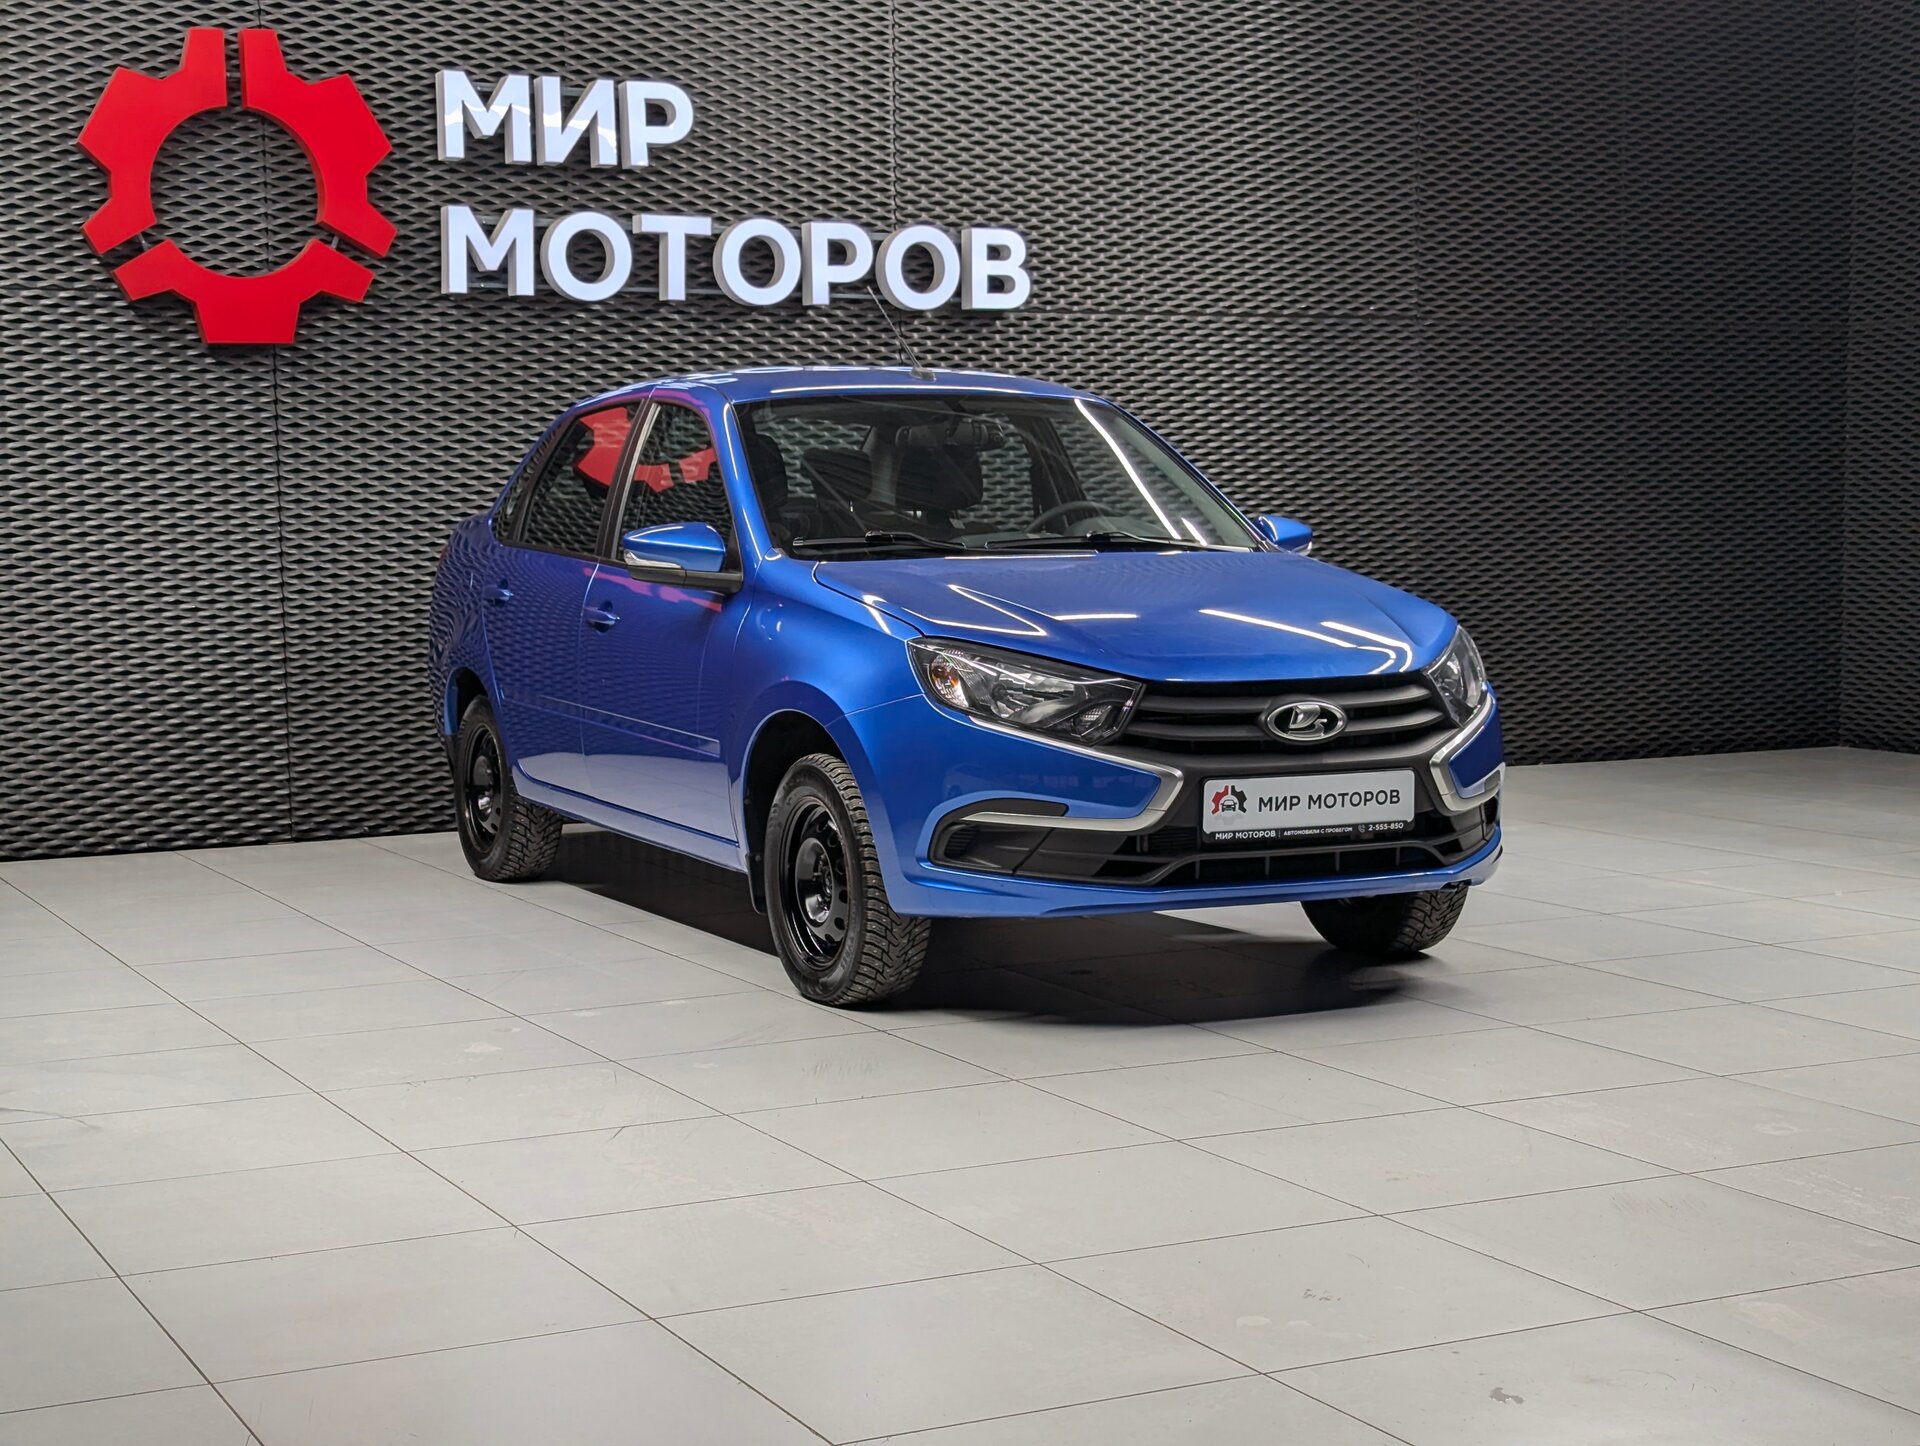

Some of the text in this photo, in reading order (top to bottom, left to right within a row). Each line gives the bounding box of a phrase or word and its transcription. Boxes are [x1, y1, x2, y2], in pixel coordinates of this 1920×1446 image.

[436, 69, 694, 170] МИР
[440, 204, 1032, 312] МОТОРОВ
[1258, 789, 1401, 813] МИР МОТОРОВ
[1215, 830, 1276, 840] МИР МОТОРОВ
[1368, 822, 1404, 831] 2-555-850
